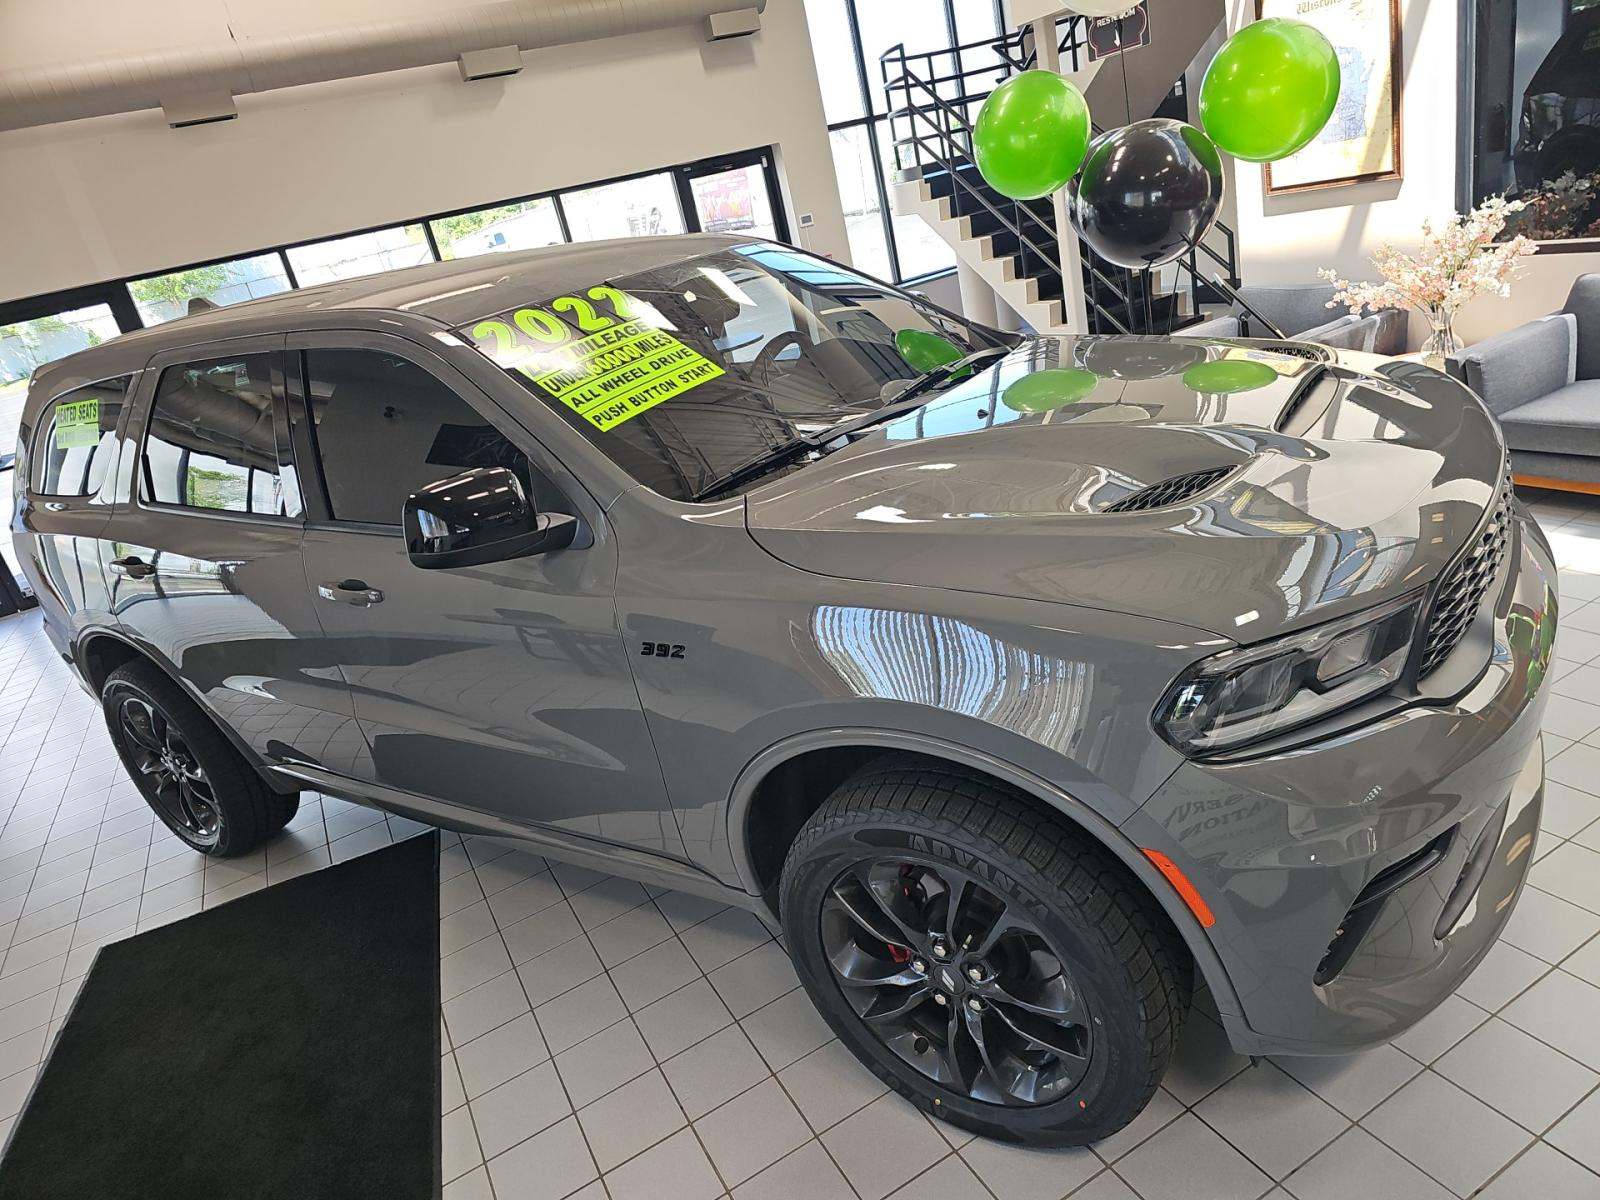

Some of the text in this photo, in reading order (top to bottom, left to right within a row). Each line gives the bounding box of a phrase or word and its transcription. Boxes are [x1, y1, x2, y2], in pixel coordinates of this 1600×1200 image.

[472, 285, 643, 361] 2022
[570, 321, 650, 357] MILEAGE
[543, 363, 591, 393] UNDER
[634, 333, 674, 354] MILES
[570, 346, 695, 408] ALL WHEEL DRIVE
[57, 402, 98, 424] HEATED SEATS
[591, 362, 717, 427] PUSH BUTTON START
[640, 641, 686, 659] 392
[911, 833, 1049, 921] ADVANTA
